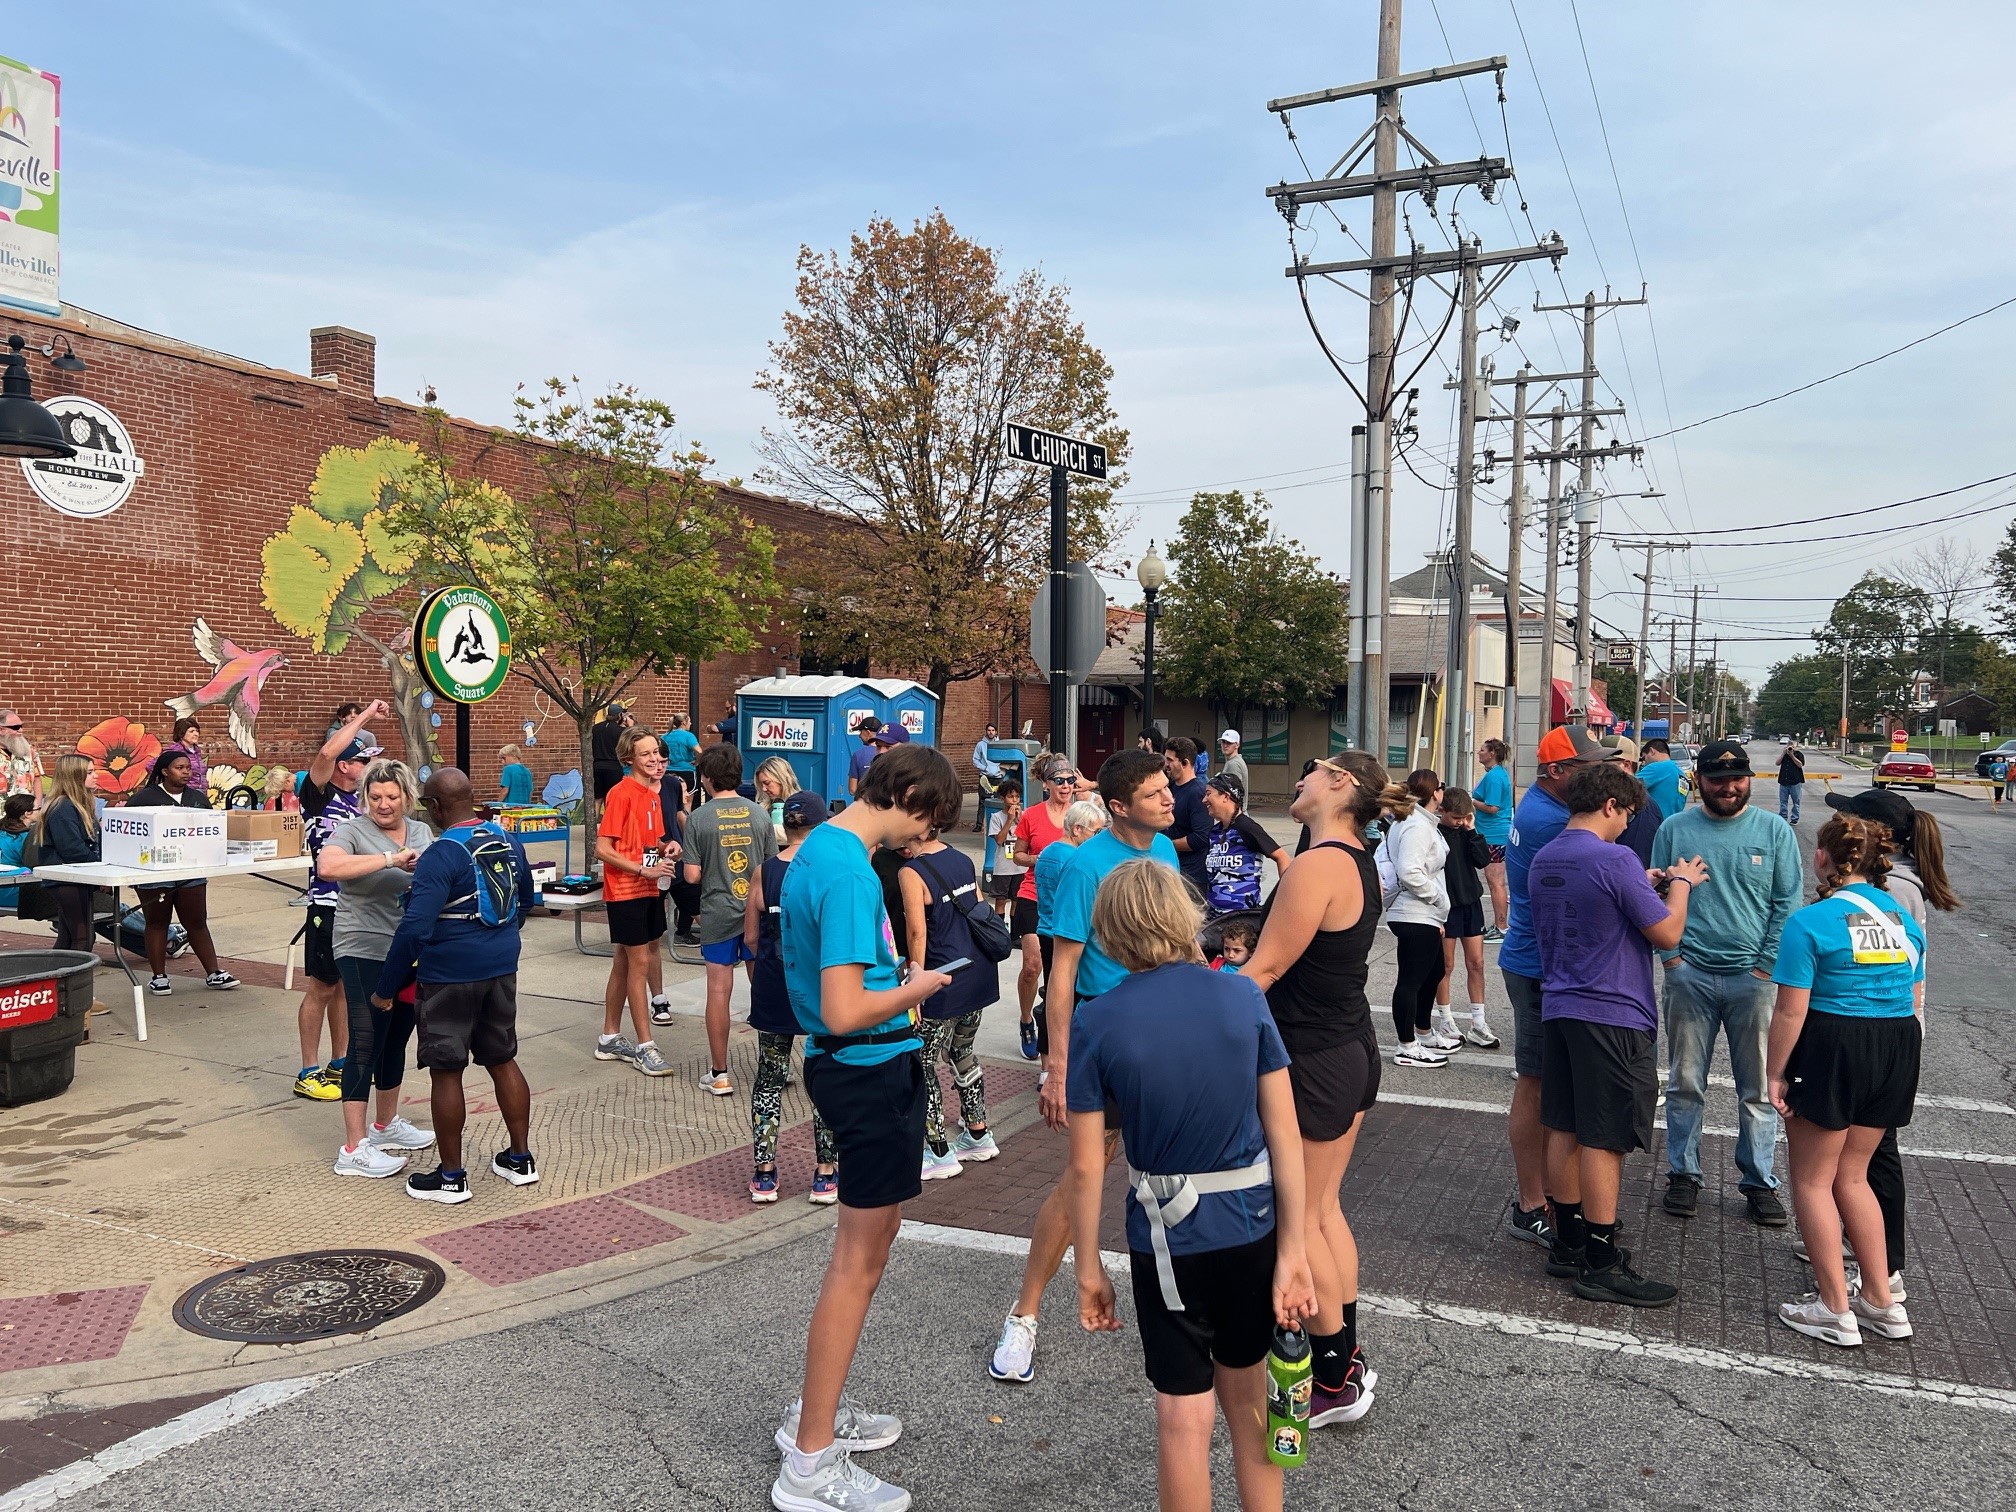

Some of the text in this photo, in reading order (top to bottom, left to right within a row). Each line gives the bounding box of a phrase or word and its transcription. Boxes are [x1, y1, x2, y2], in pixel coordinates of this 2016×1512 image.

[0, 249, 56, 277] lleville
[19, 271, 55, 285] COMMERCE
[1010, 427, 1104, 472] N. CHURCH ST.
[48, 464, 109, 480] HOMEBREW
[95, 453, 141, 473] HALL
[441, 590, 494, 615] Paderborn
[453, 684, 486, 700] Square
[104, 818, 149, 837] JERZEES
[162, 826, 220, 838] JERZEES
[0, 989, 54, 1012] eiser.
